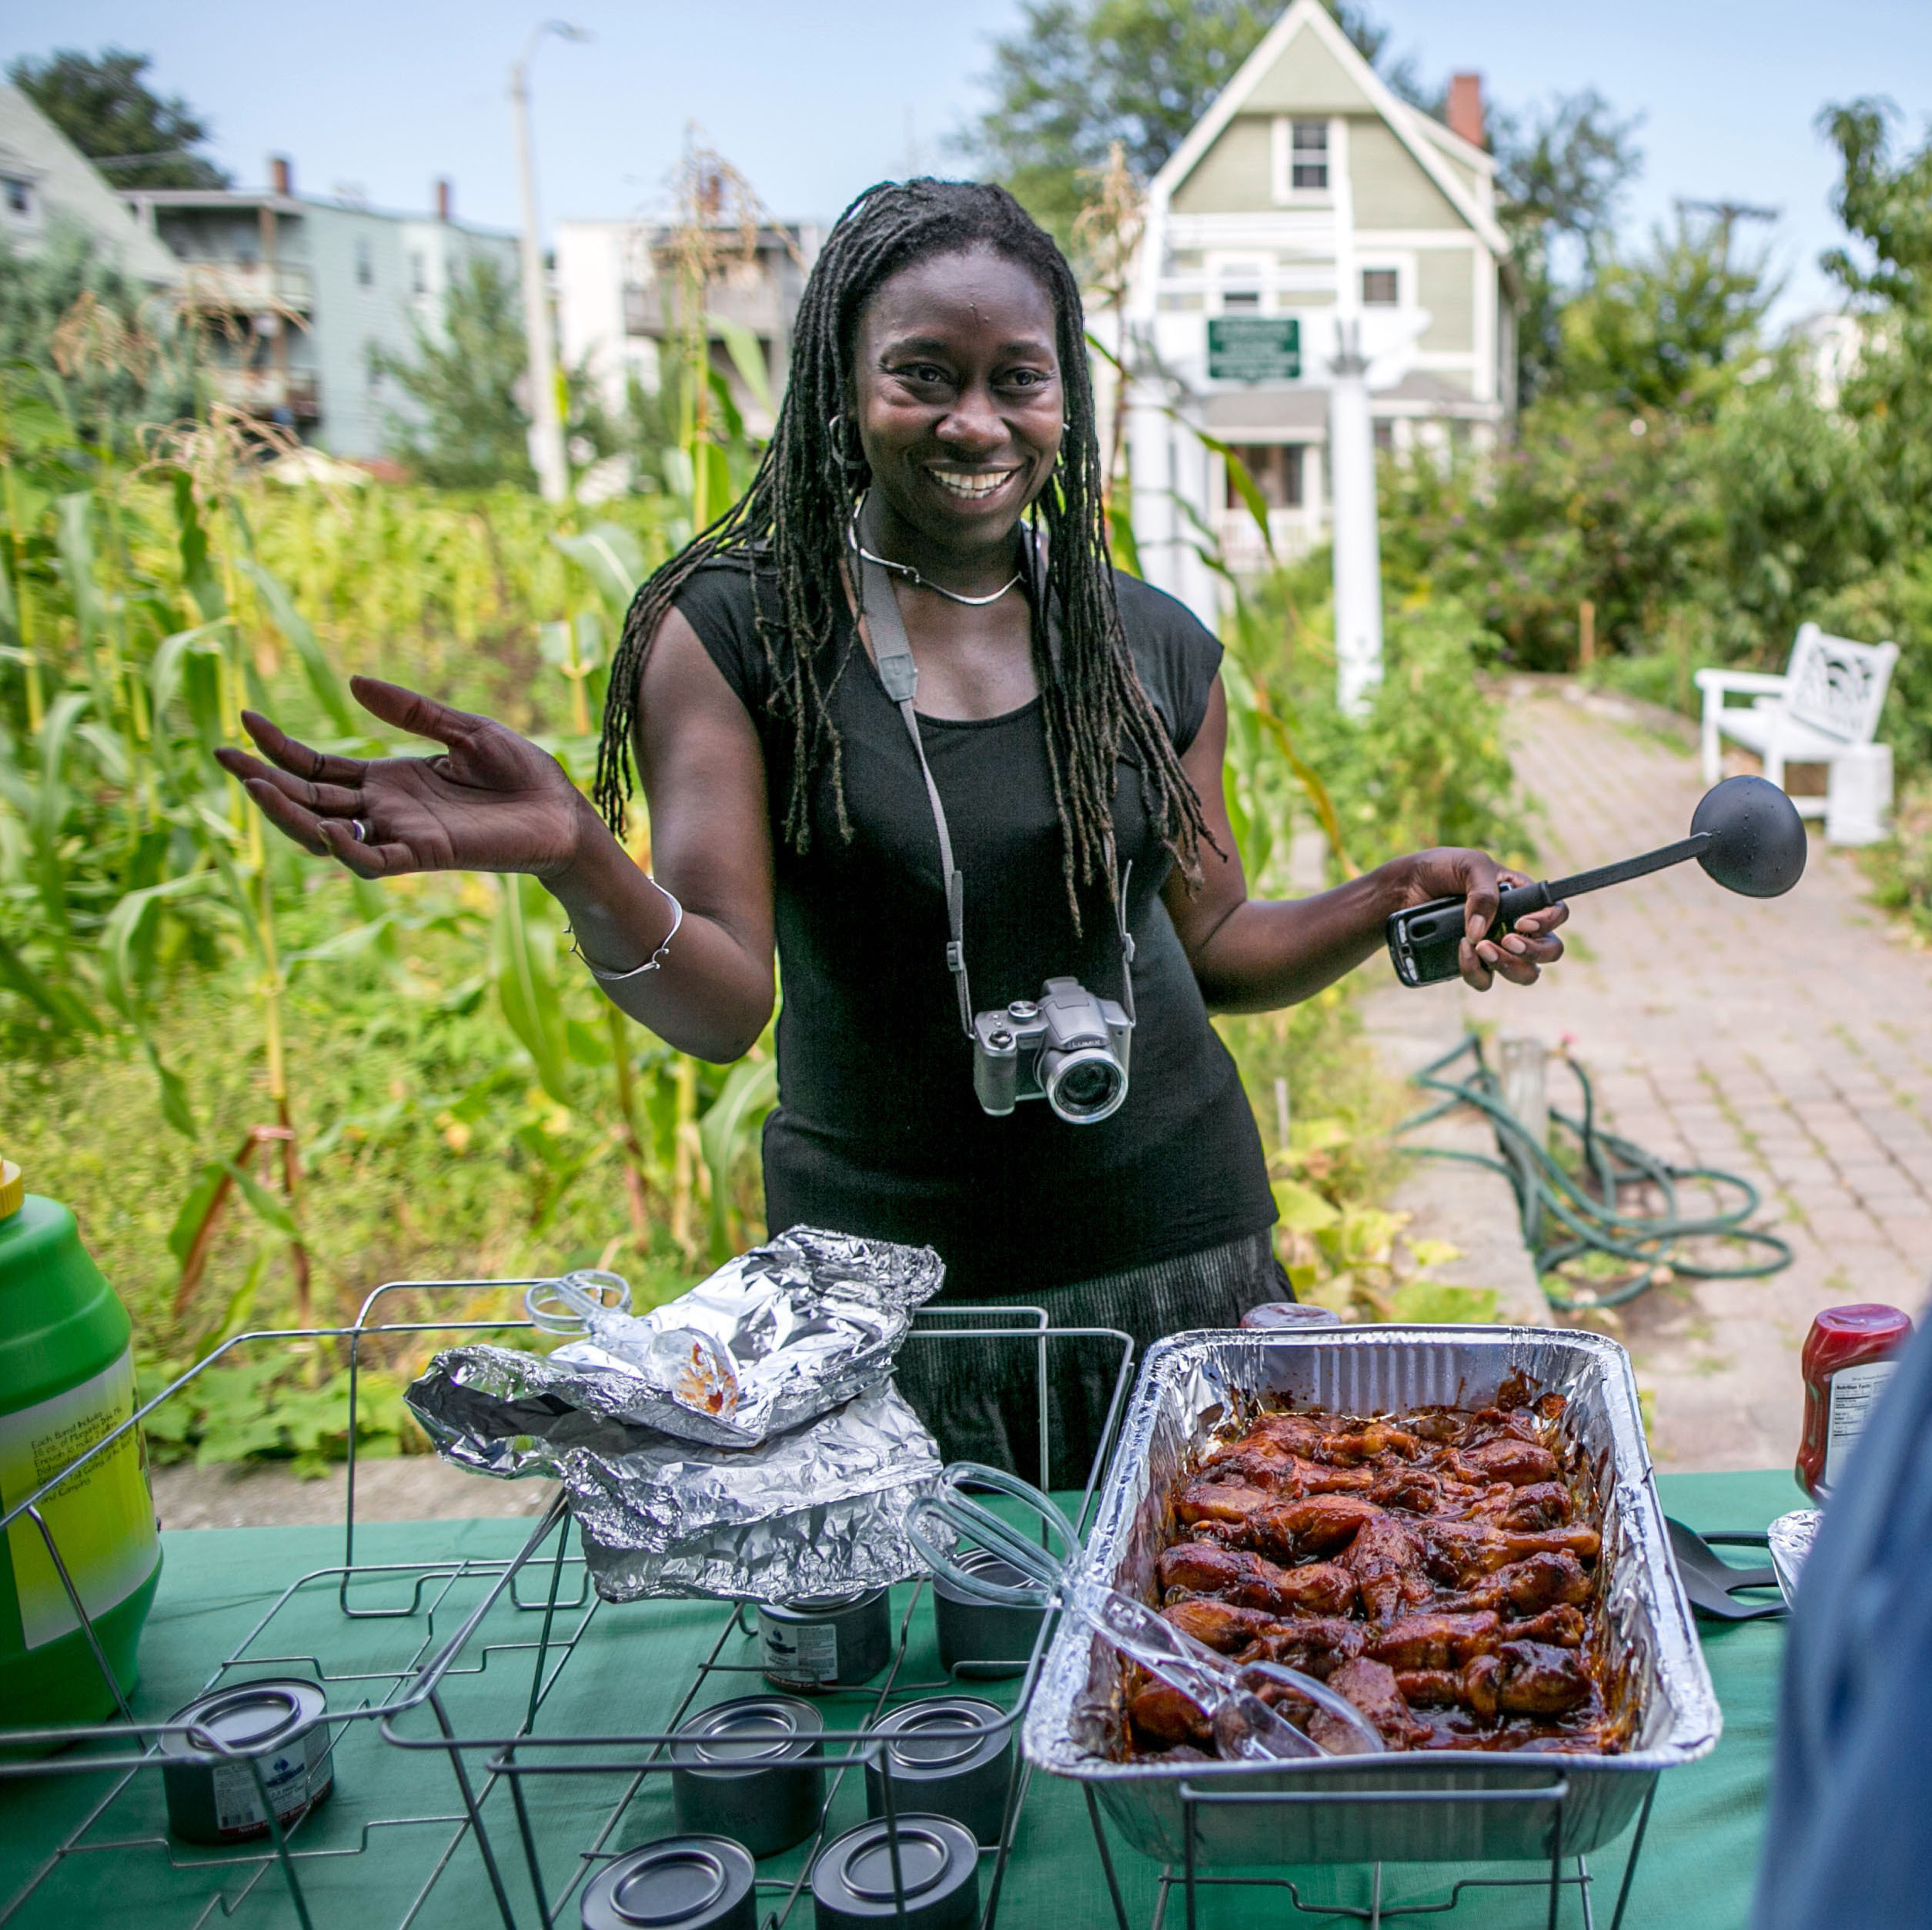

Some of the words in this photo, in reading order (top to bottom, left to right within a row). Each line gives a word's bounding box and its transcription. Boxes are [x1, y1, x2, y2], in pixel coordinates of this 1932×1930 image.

[1071, 1039, 1101, 1047] LUMIX
[32, 1434, 53, 1451] Each
[55, 1423, 76, 1440] Barrel
[34, 1451, 65, 1468] Enough
